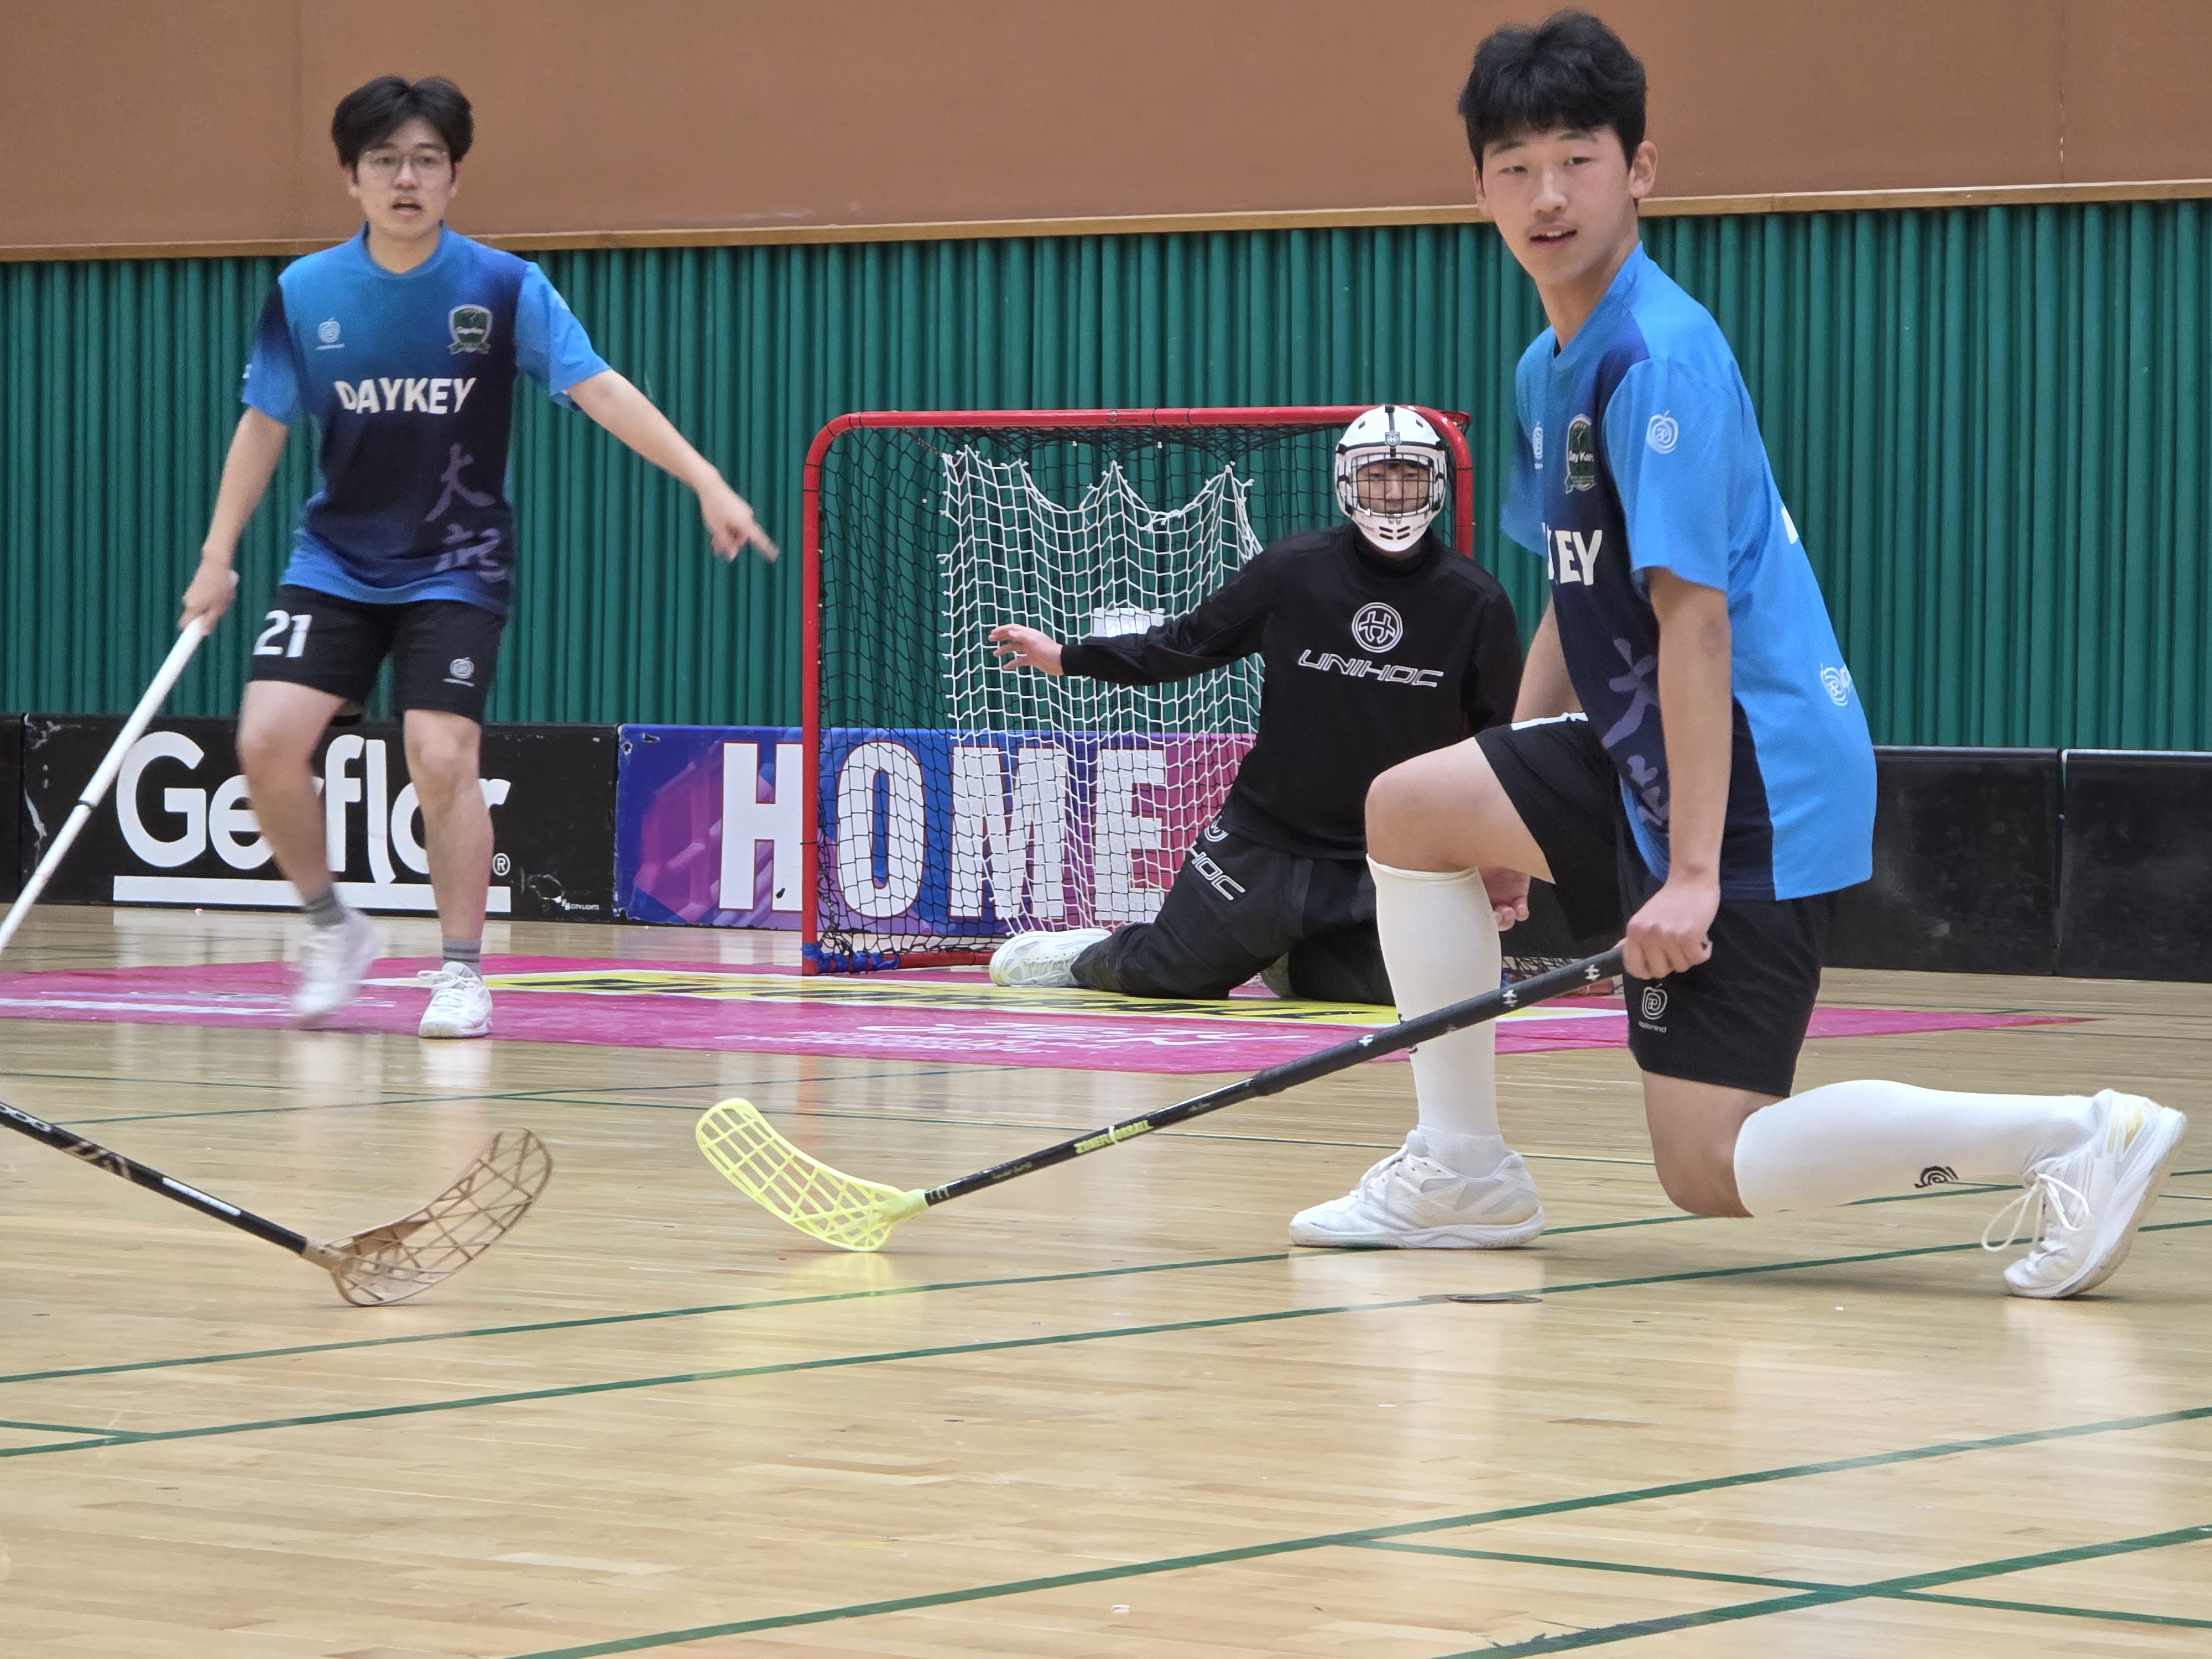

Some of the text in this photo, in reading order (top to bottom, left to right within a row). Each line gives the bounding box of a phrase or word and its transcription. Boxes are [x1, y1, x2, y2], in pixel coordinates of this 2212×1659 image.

[333, 377, 476, 415] DAYKEY
[252, 609, 313, 658] 21
[1298, 649, 1444, 687] UNIHOC
[718, 742, 1166, 920] HOME
